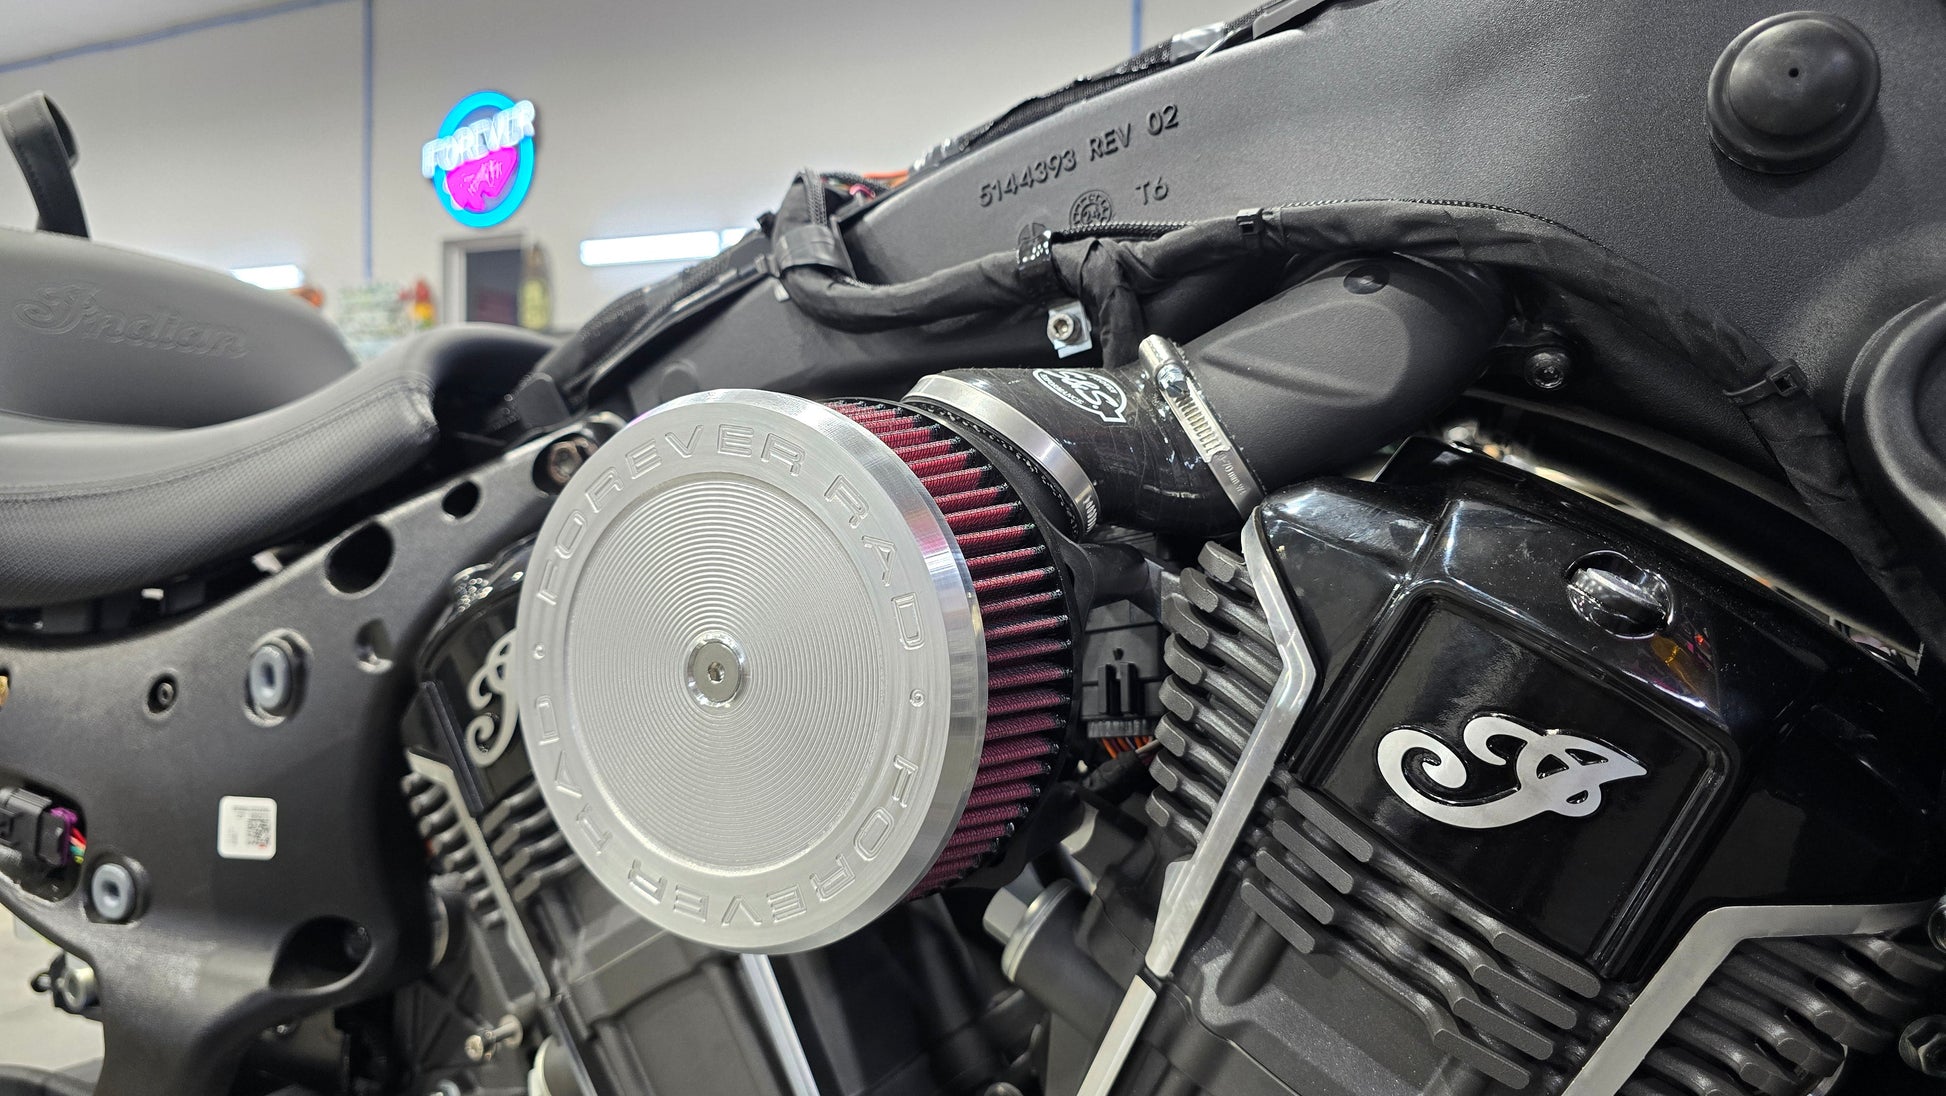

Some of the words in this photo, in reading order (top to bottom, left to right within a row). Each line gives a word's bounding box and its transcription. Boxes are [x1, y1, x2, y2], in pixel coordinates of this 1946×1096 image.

[979, 149, 1077, 208] 5144393
[1089, 122, 1132, 162] REV
[1148, 103, 1180, 136] 02
[1135, 177, 1169, 206] T6
[14, 280, 249, 360] Indian
[537, 424, 806, 606] FOREVER
[825, 474, 925, 650] RAD
[535, 695, 613, 855] RAD
[627, 754, 919, 926] FOREVER
